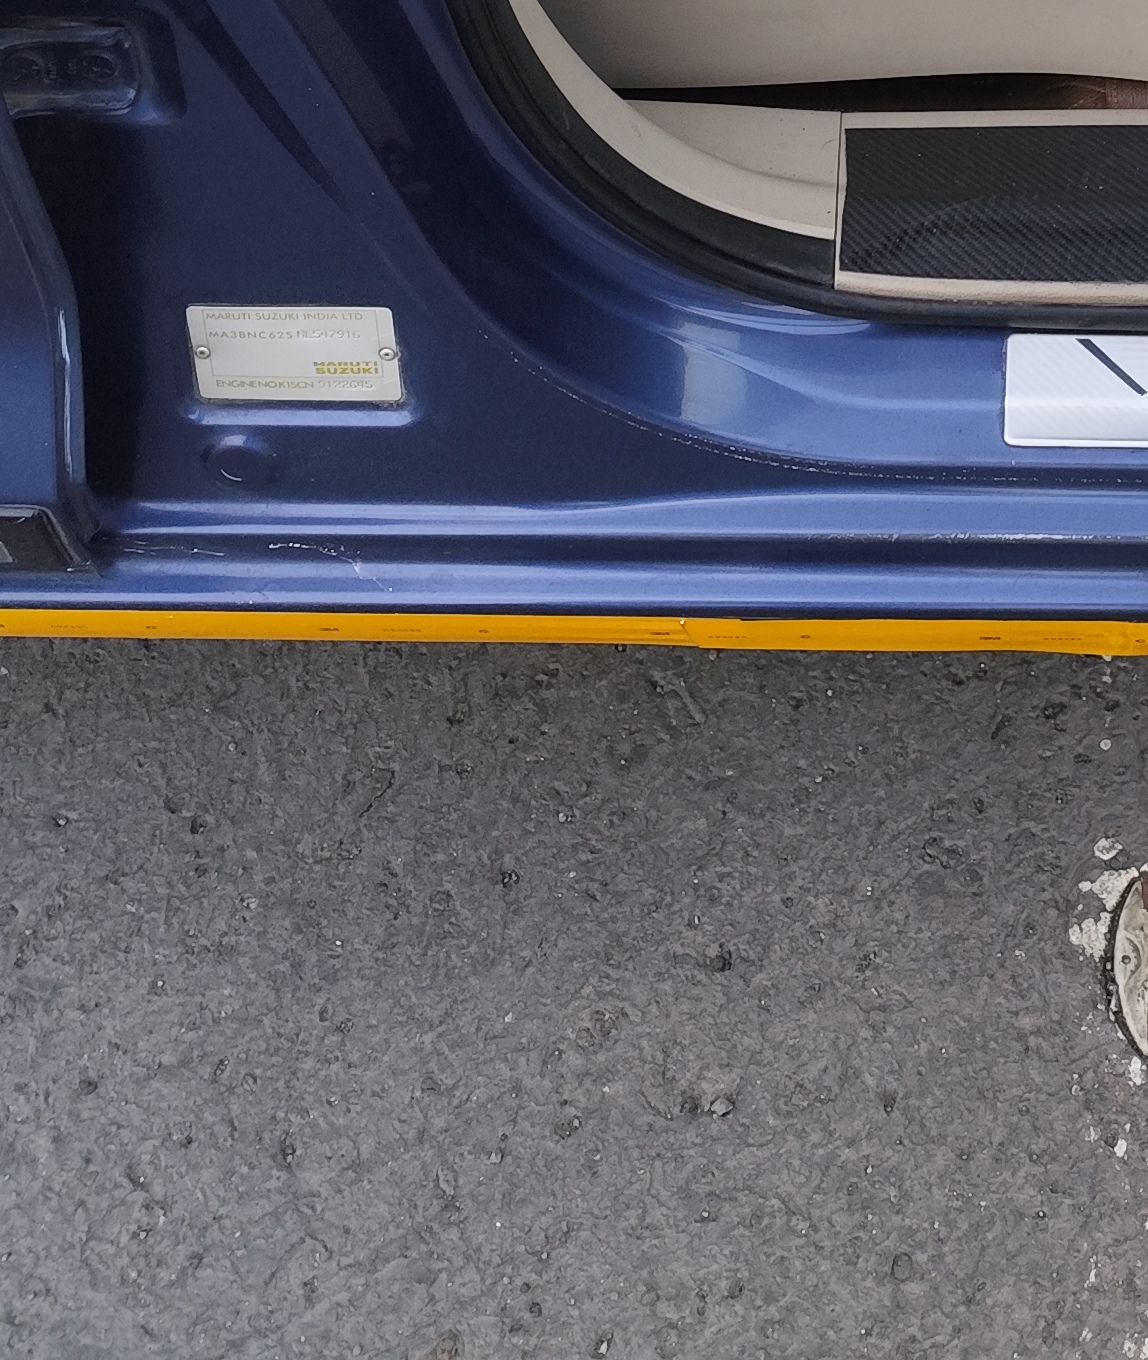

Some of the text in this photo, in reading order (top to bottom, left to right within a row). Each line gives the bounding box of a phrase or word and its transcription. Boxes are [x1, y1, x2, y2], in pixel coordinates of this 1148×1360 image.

[206, 312, 251, 321] MARUTI
[255, 312, 299, 321] SUZUKI
[303, 312, 338, 321] INDIA
[315, 367, 379, 375] SUZUKI
